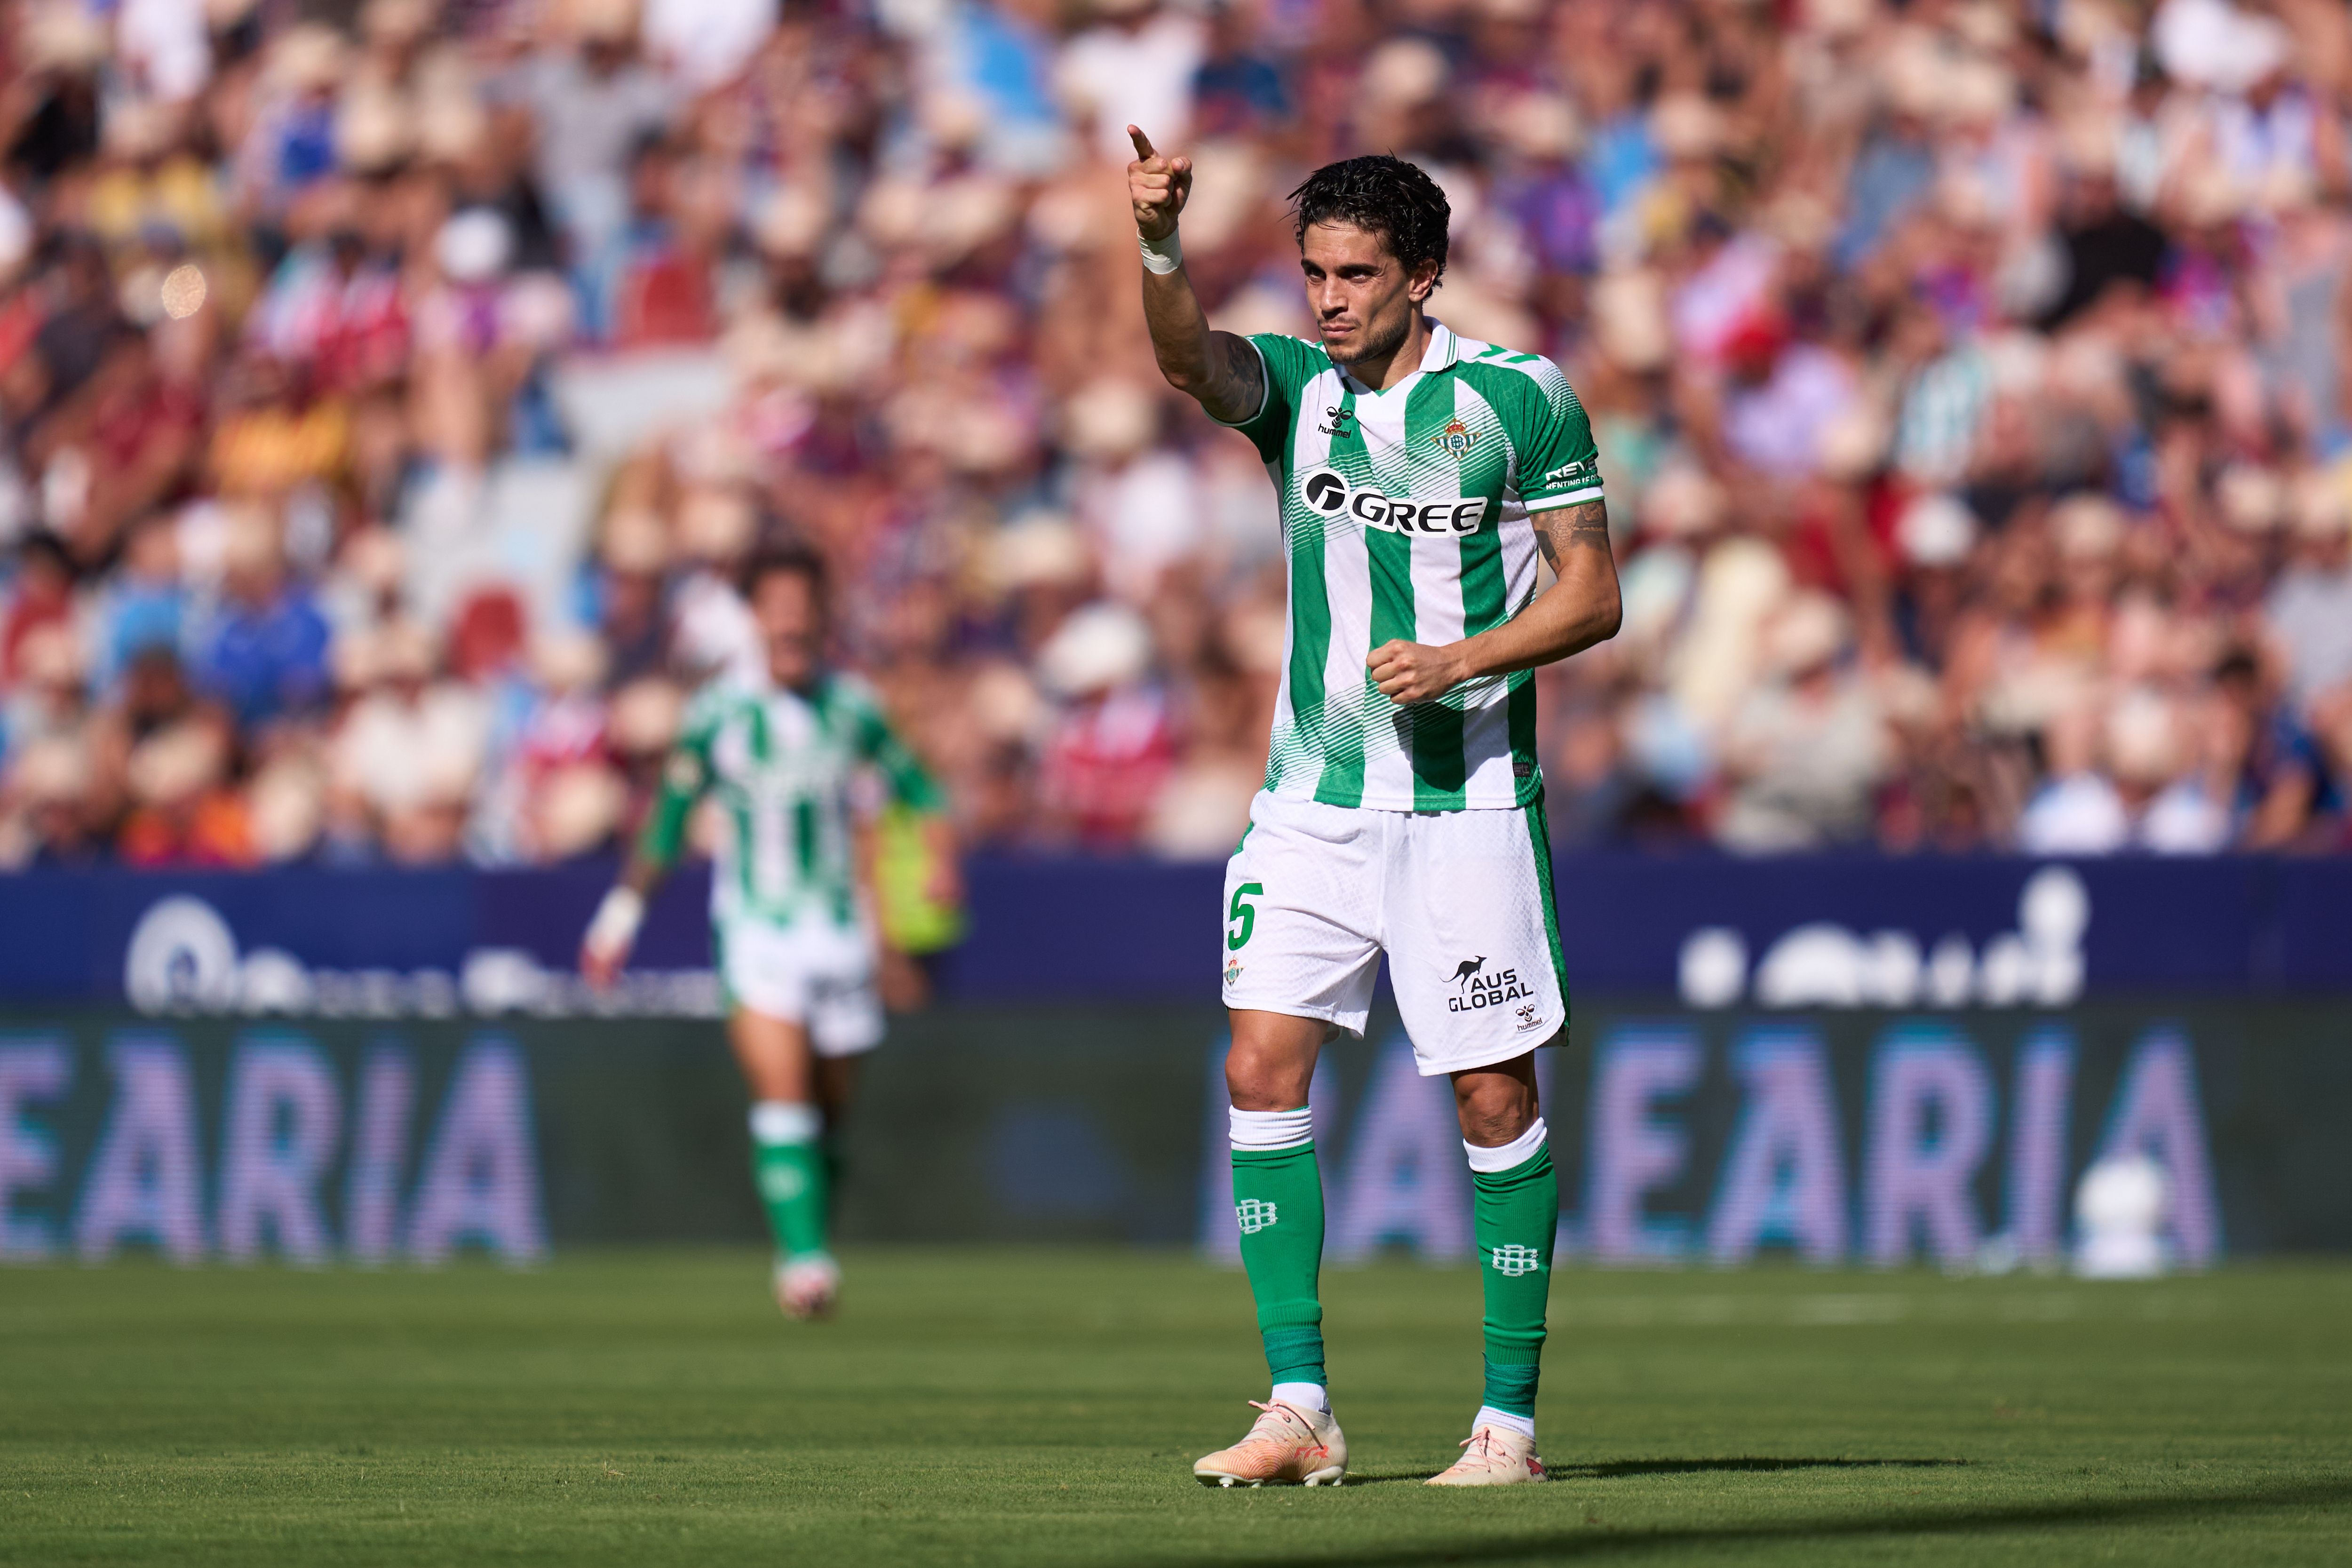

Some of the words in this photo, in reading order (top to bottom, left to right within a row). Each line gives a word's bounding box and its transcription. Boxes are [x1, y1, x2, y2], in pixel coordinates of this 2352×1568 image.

[1318, 423, 1352, 439] hummel
[1352, 493, 1483, 533] GREE
[1228, 883, 1264, 951] 5
[1470, 968, 1517, 993] AUS
[1448, 982, 1534, 1012] GLOBAL
[1517, 1017, 1543, 1032] hummel
